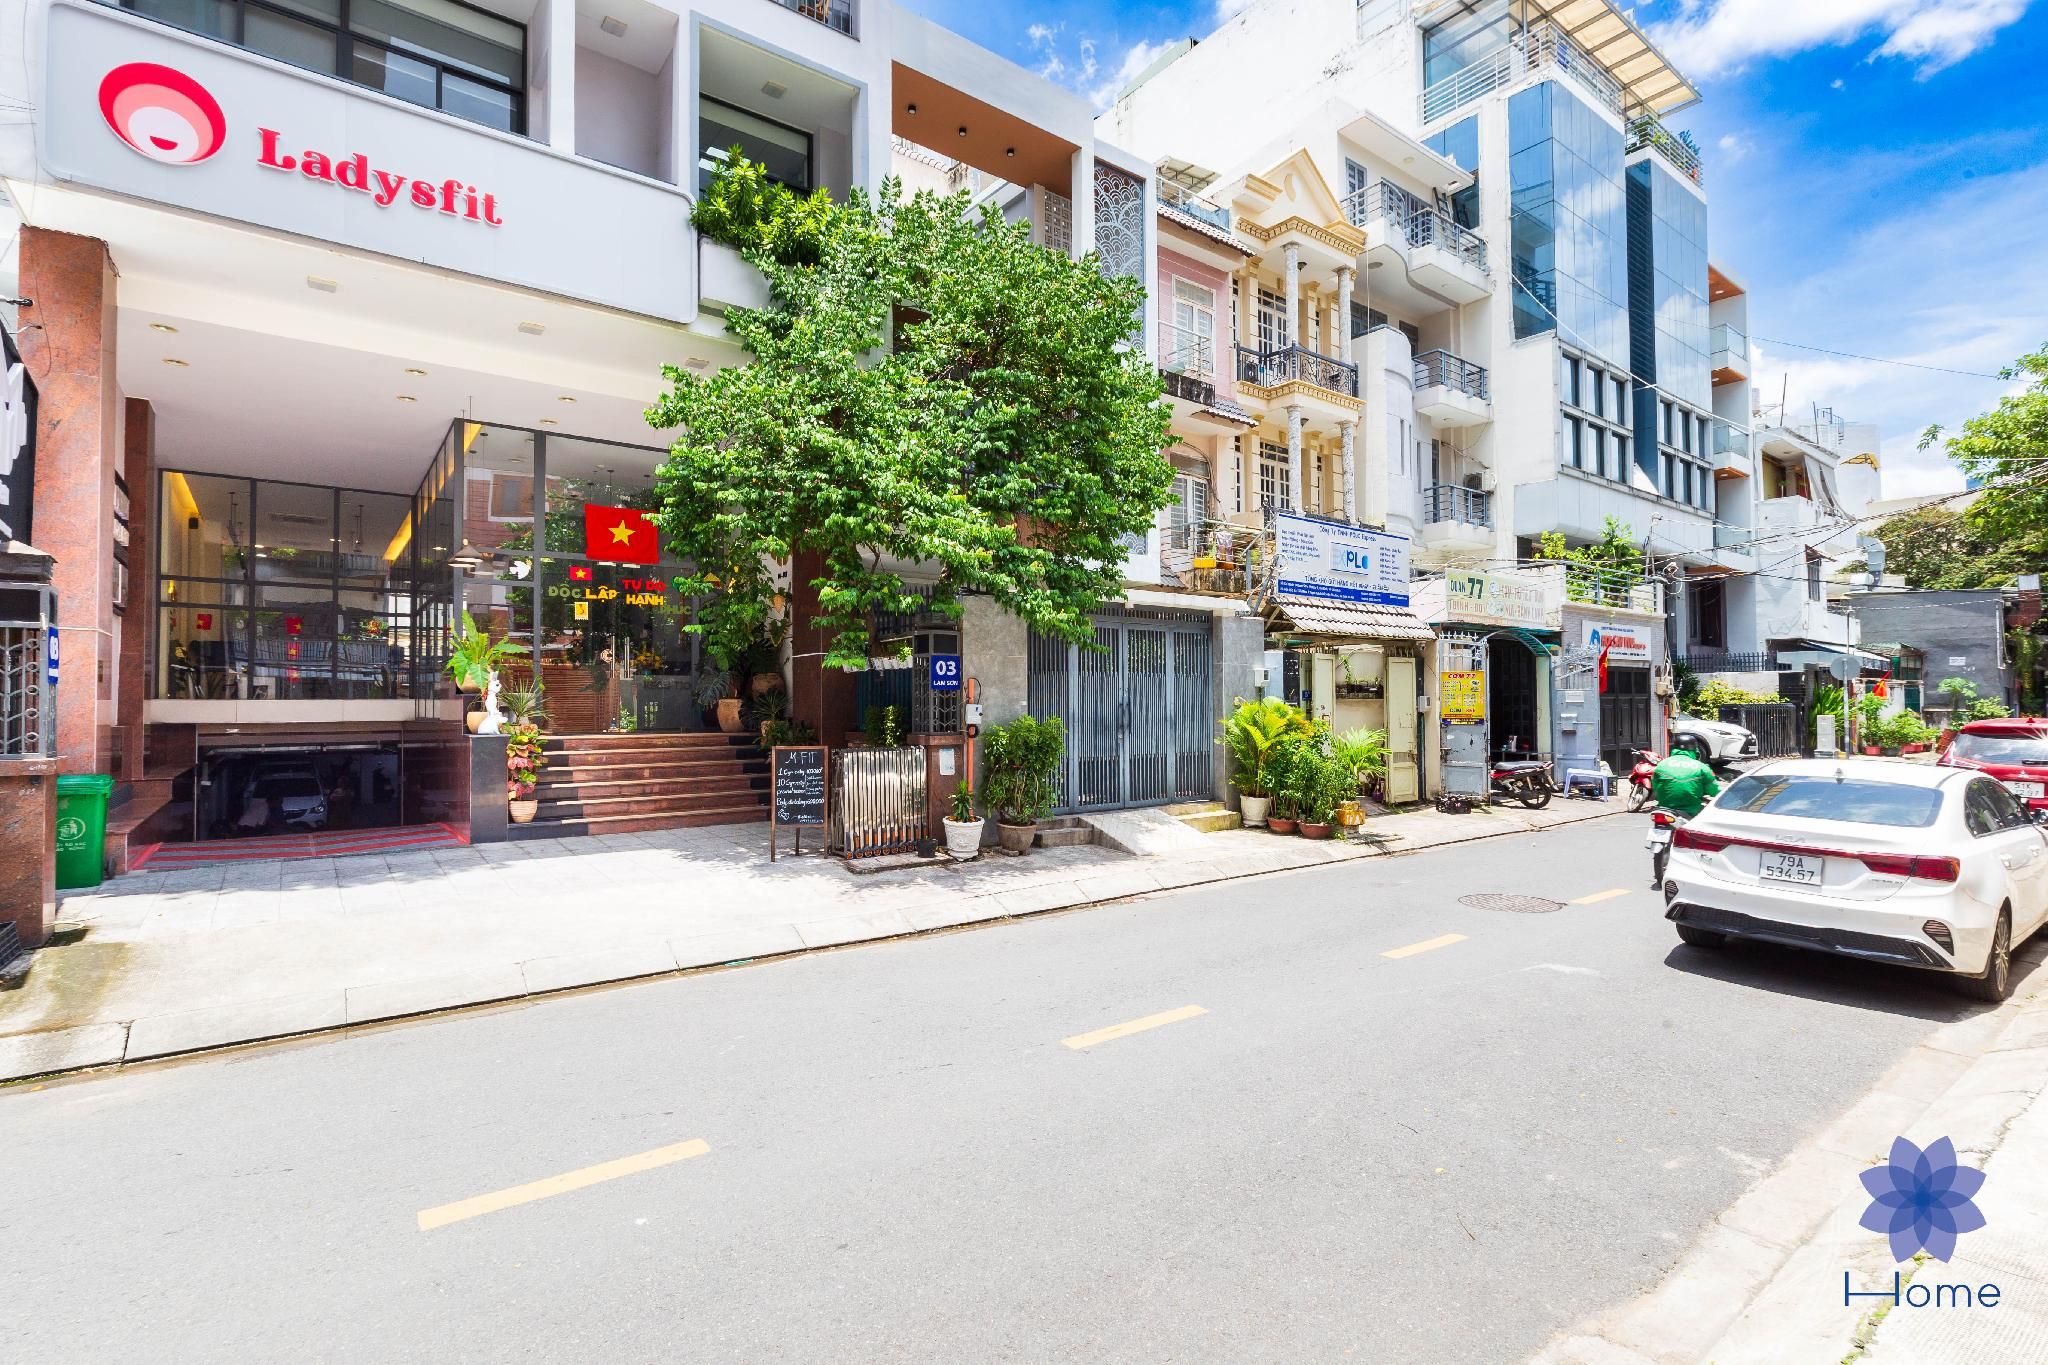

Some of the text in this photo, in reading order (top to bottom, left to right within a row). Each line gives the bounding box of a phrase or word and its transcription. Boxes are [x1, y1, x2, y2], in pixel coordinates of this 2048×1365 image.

[257, 127, 503, 226] Ladysfit
[584, 585, 618, 603] LẬP
[1467, 576, 1484, 600] 77
[626, 594, 664, 607] HẠNH
[936, 661, 956, 675] 03
[801, 752, 817, 764] FIT
[1778, 855, 1804, 869] 79A
[1766, 865, 1815, 881] 534.57
